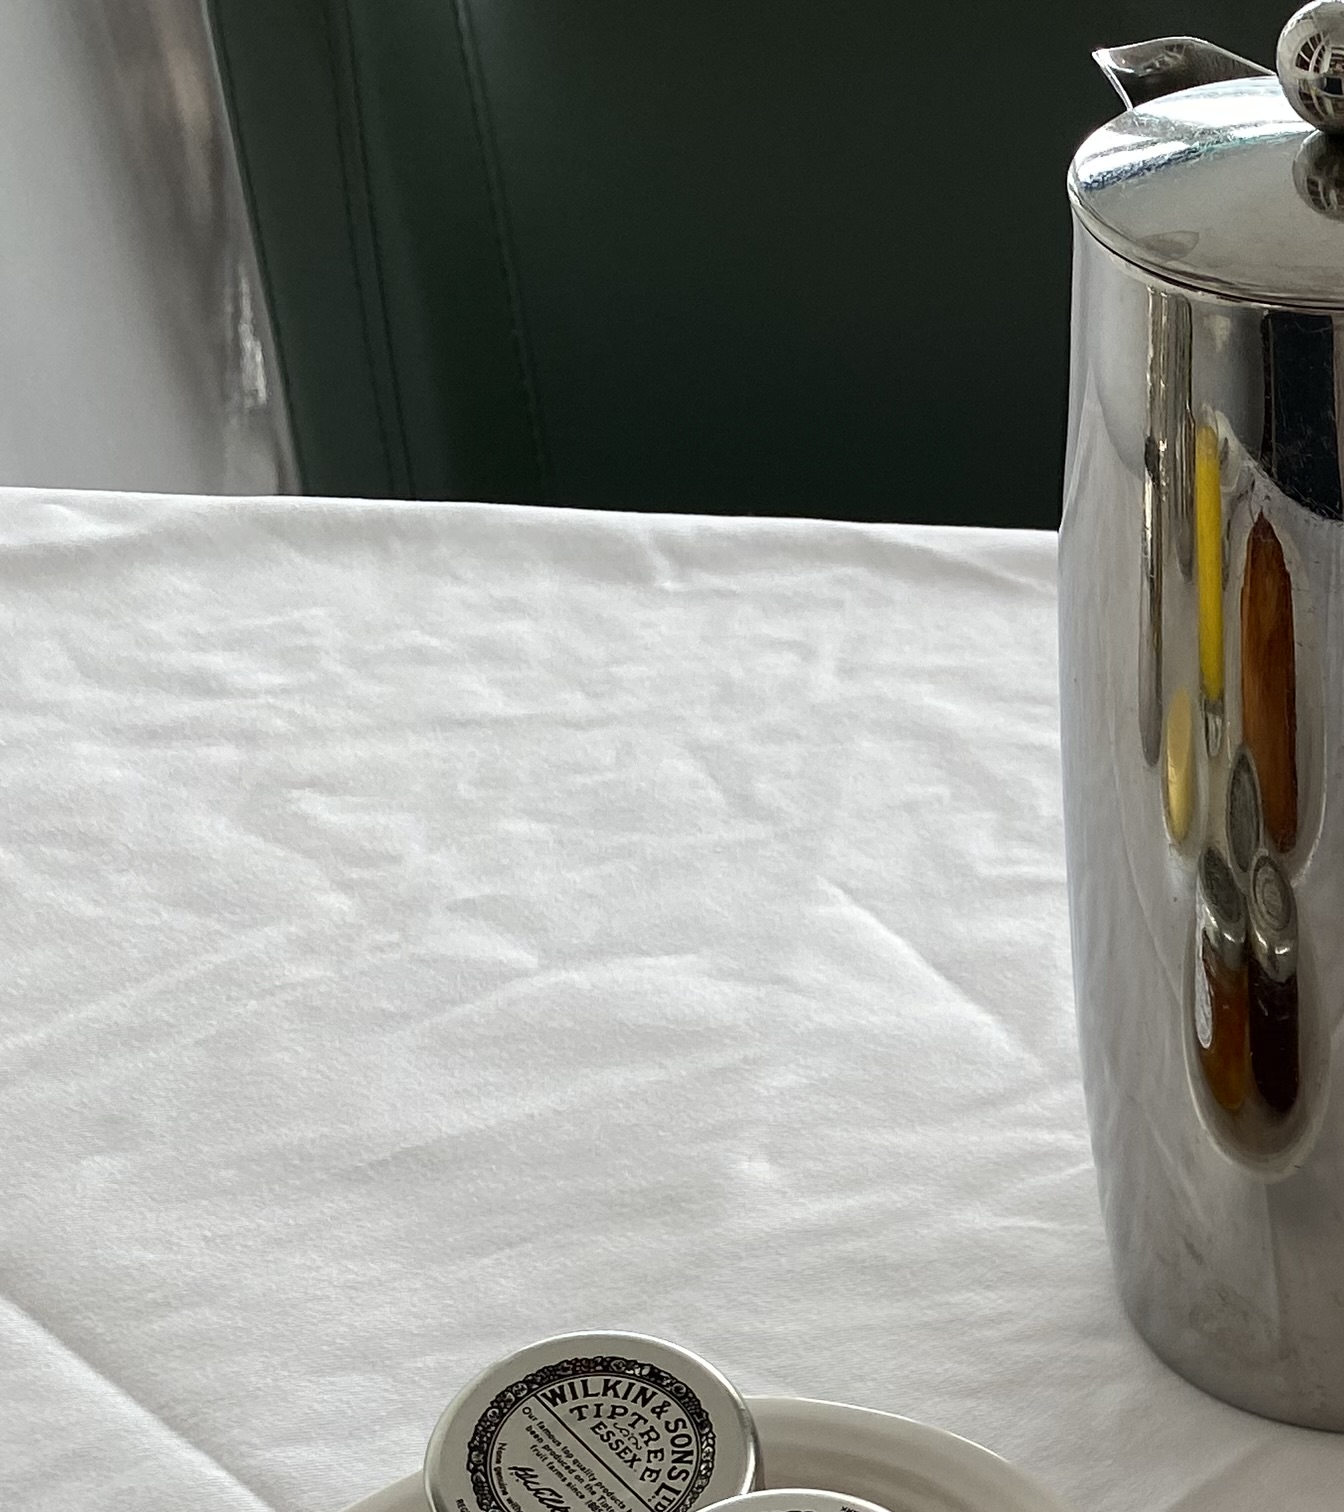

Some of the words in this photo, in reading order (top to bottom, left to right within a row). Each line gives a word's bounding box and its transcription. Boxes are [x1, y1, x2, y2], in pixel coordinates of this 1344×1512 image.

[522, 1406, 538, 1421] Our
[536, 1421, 562, 1447] famous
[561, 1445, 574, 1459] top
[572, 1458, 597, 1482] quality
[594, 1481, 626, 1509] products
[525, 1424, 544, 1444] been
[541, 1444, 577, 1475] produced
[574, 1474, 585, 1484] on
[584, 1483, 597, 1496] the
[540, 1378, 658, 1408] WILKIN
[650, 1400, 672, 1420] &
[664, 1418, 694, 1482] SONS
[569, 1403, 665, 1483] TIPTREE
[530, 1444, 548, 1463] fruit
[546, 1461, 567, 1483] farms
[566, 1481, 585, 1500] since
